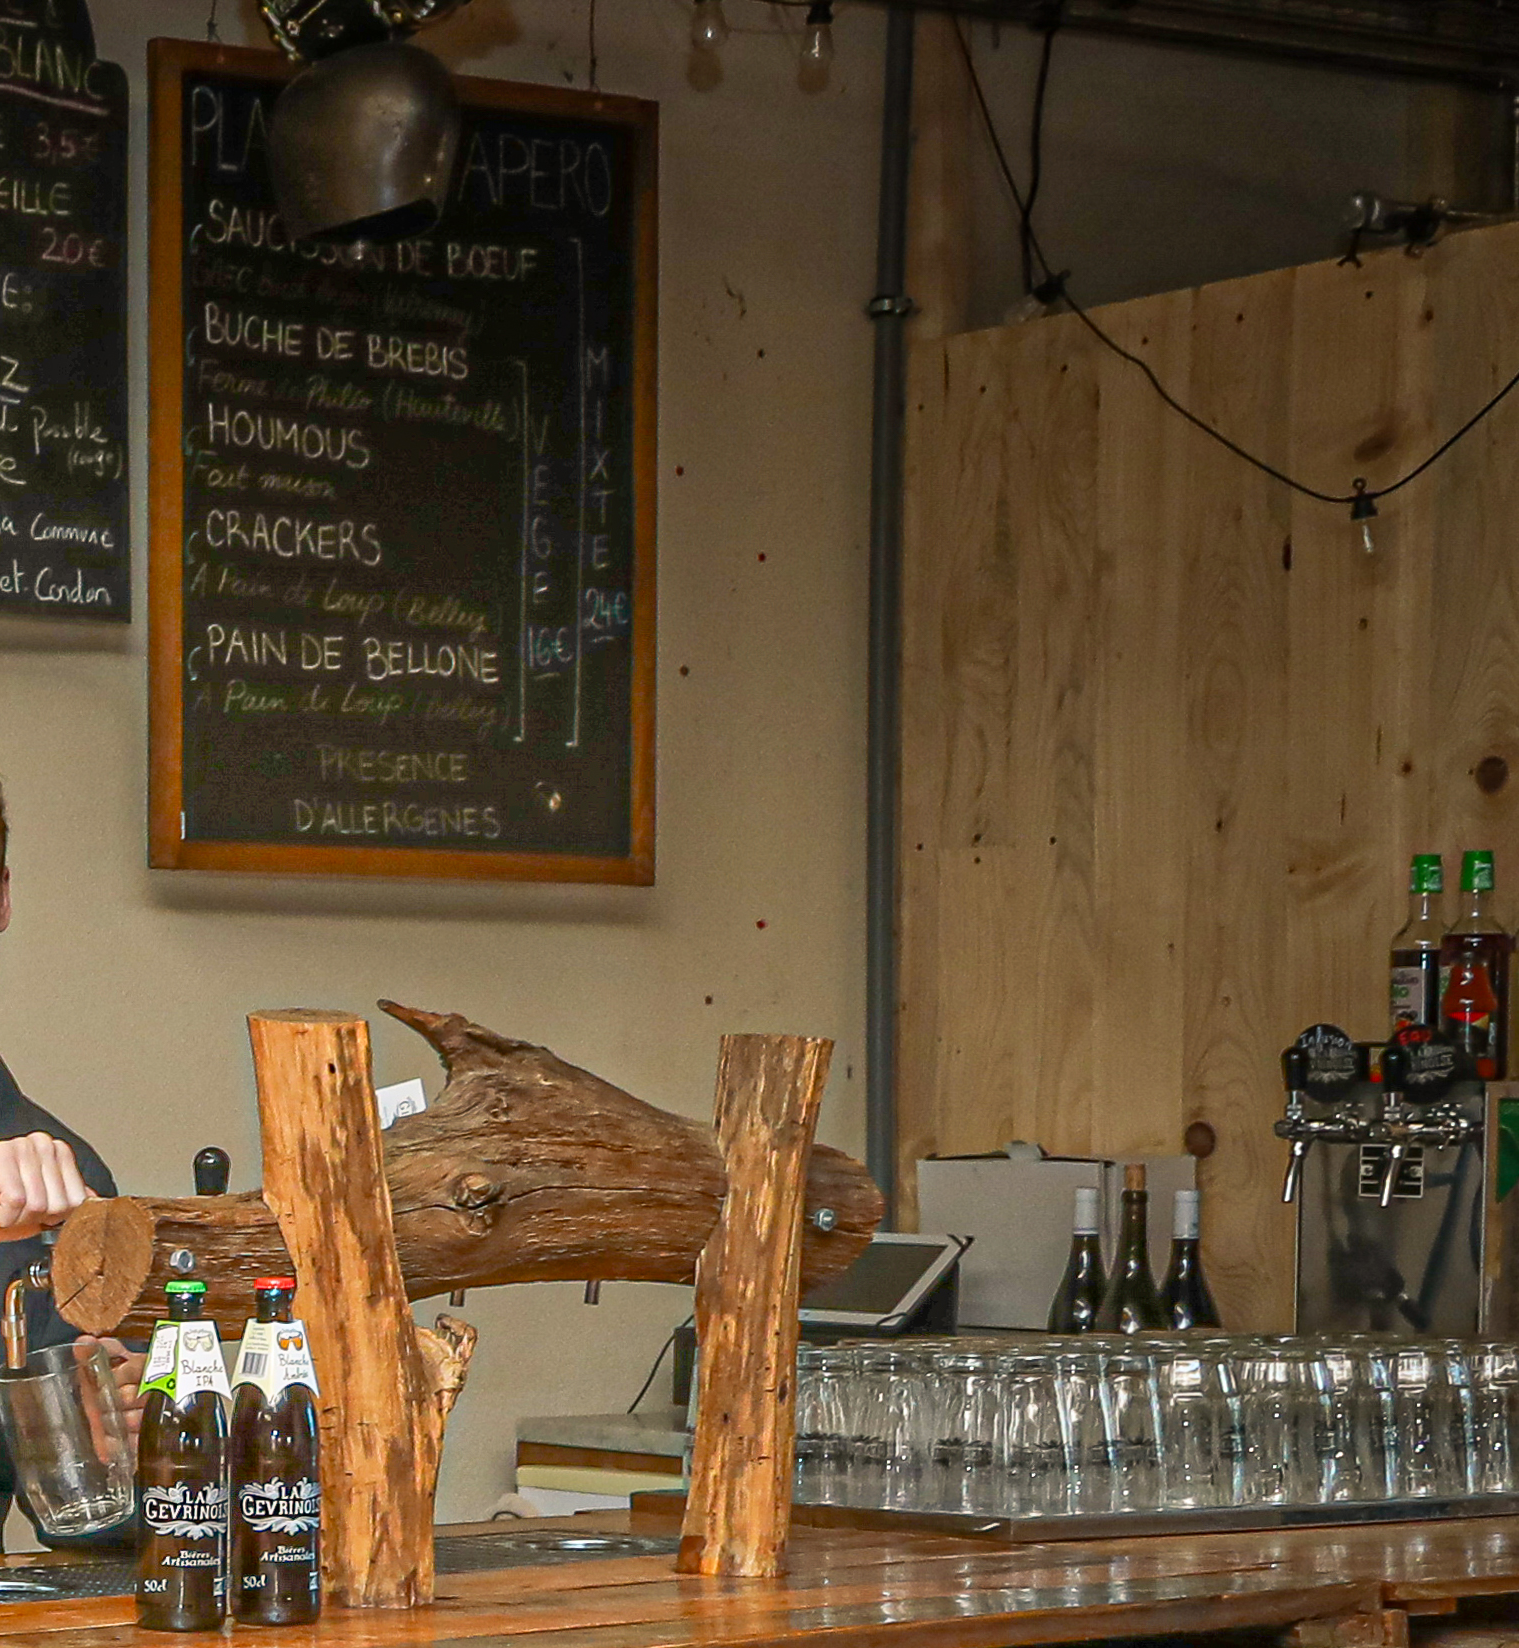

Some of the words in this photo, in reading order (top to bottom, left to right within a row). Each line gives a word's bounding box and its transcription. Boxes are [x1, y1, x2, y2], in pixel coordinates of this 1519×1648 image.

[459, 131, 613, 217] APERO
[204, 301, 302, 357] BUCHE
[316, 326, 356, 361] DE
[366, 334, 470, 382] BREBIS
[207, 403, 372, 470] HOUMOUS
[206, 509, 382, 567] CRACKERS
[206, 623, 288, 668] PAIN
[300, 635, 344, 670] DE
[363, 637, 500, 684] BELLONE
[319, 742, 469, 782] PRESENCE
[292, 799, 502, 840] D'ALLERGENES
[185, 1491, 205, 1504] LA
[280, 1486, 298, 1500] LA
